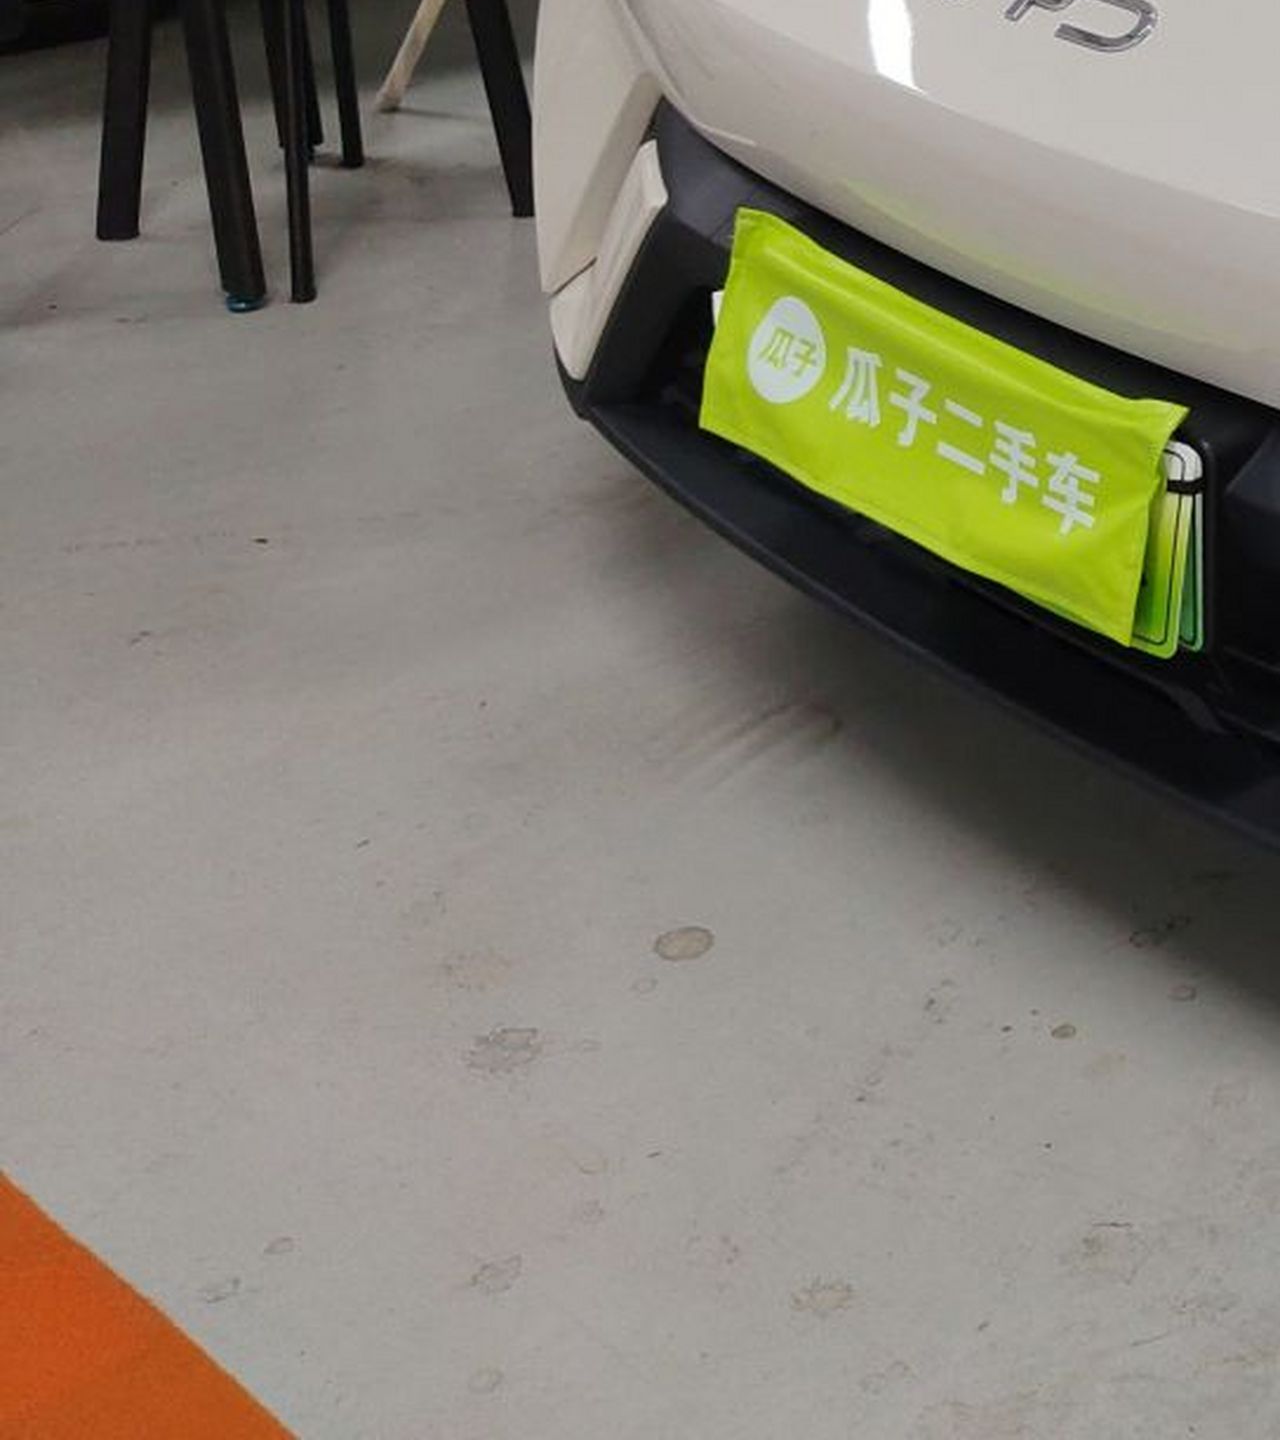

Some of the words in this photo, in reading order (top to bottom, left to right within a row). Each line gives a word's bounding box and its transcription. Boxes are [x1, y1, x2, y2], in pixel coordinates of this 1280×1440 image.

[760, 327, 816, 378] 瓜子
[828, 345, 1101, 536] 瓜子二手车
